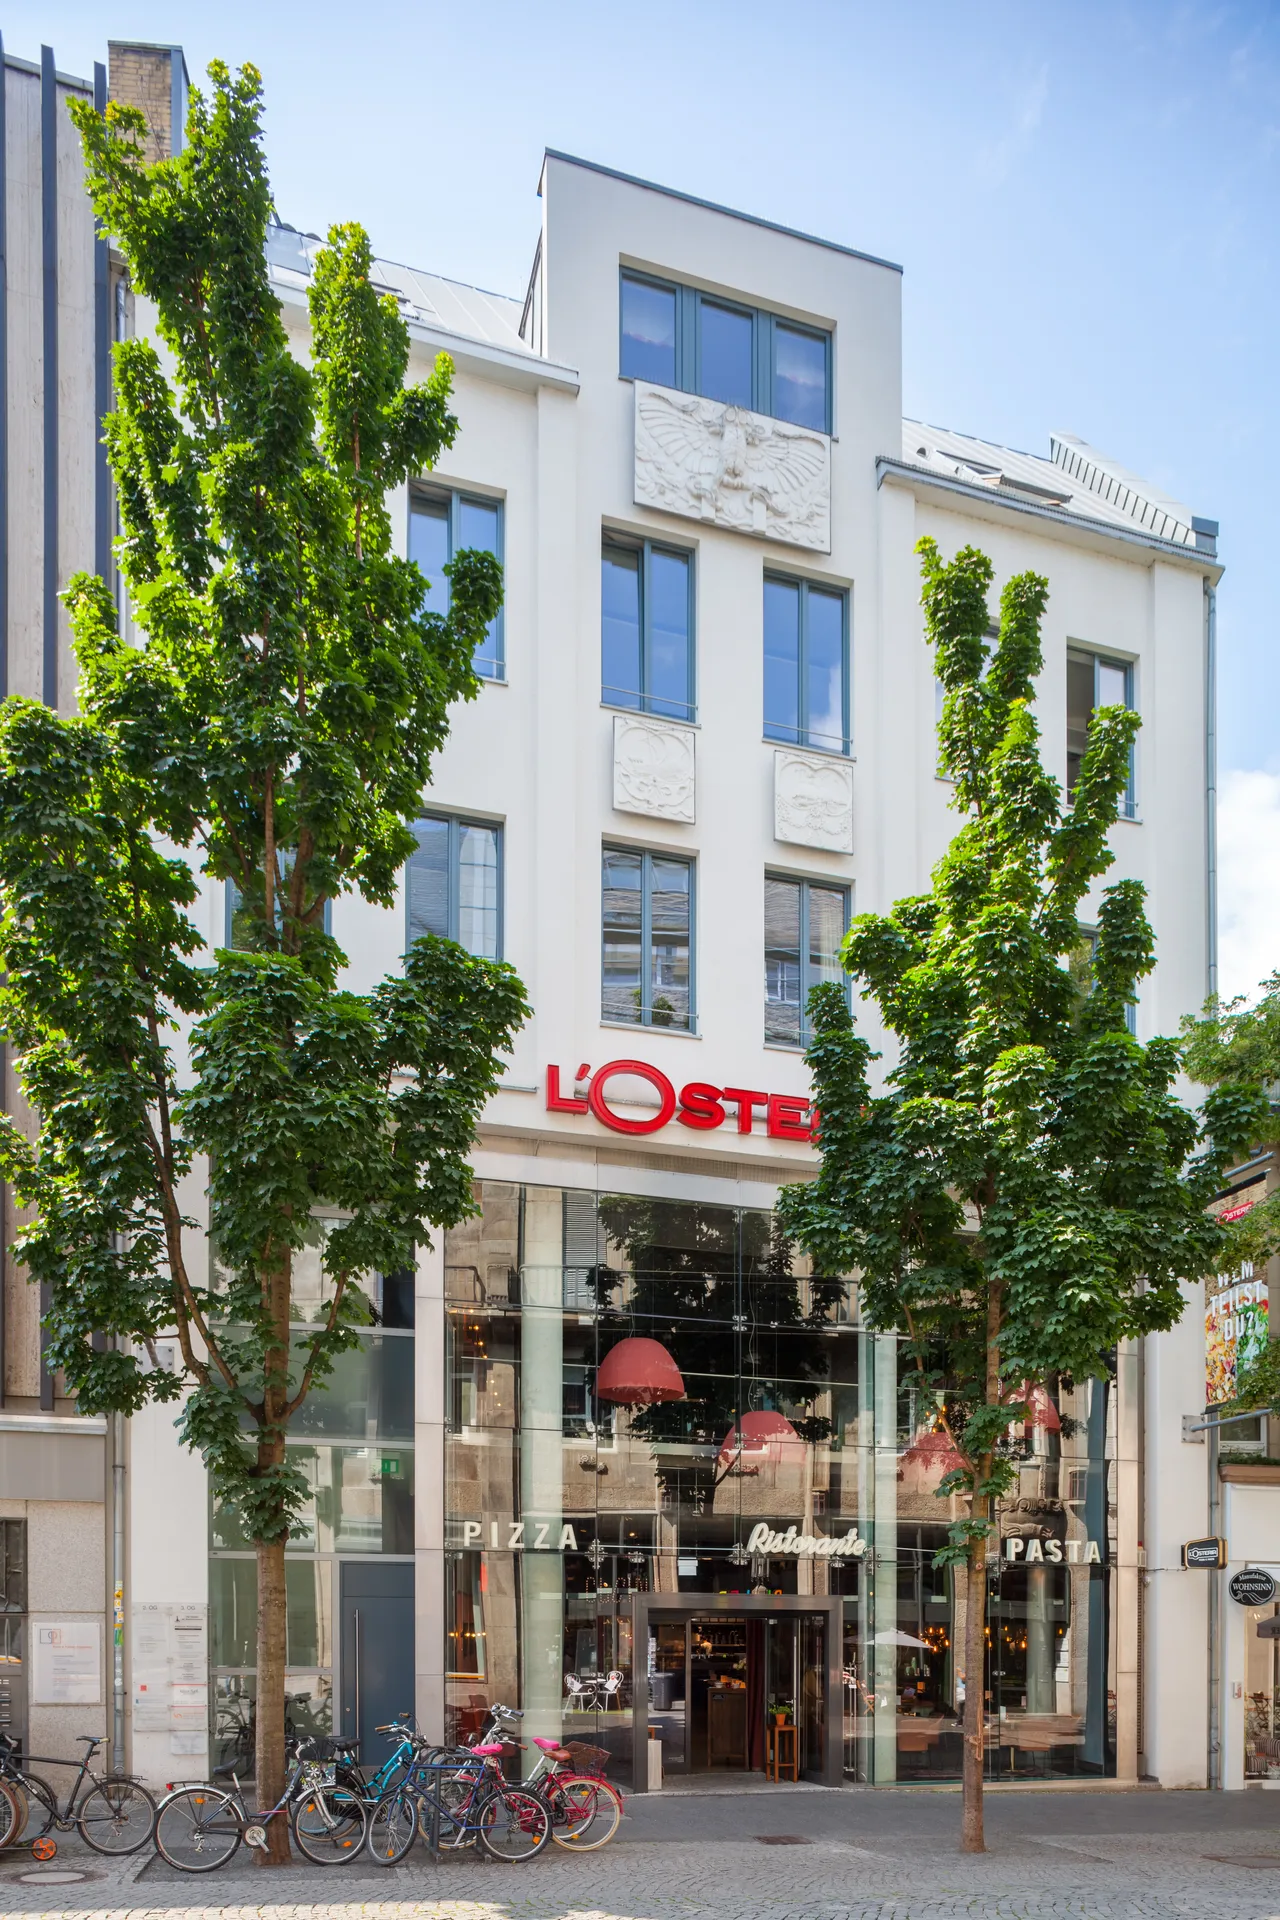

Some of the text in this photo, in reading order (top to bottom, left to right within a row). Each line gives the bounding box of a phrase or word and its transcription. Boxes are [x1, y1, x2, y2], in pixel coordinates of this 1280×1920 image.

[546, 1059, 824, 1144] L'OSTE
[1210, 1280, 1262, 1318] TEILST
[1224, 1311, 1254, 1341] DU?
[463, 1521, 578, 1550] PIZZA
[747, 1522, 866, 1556] Ristorante
[1006, 1538, 1101, 1563] PASTA
[1232, 1583, 1272, 1591] WOHNSINN
